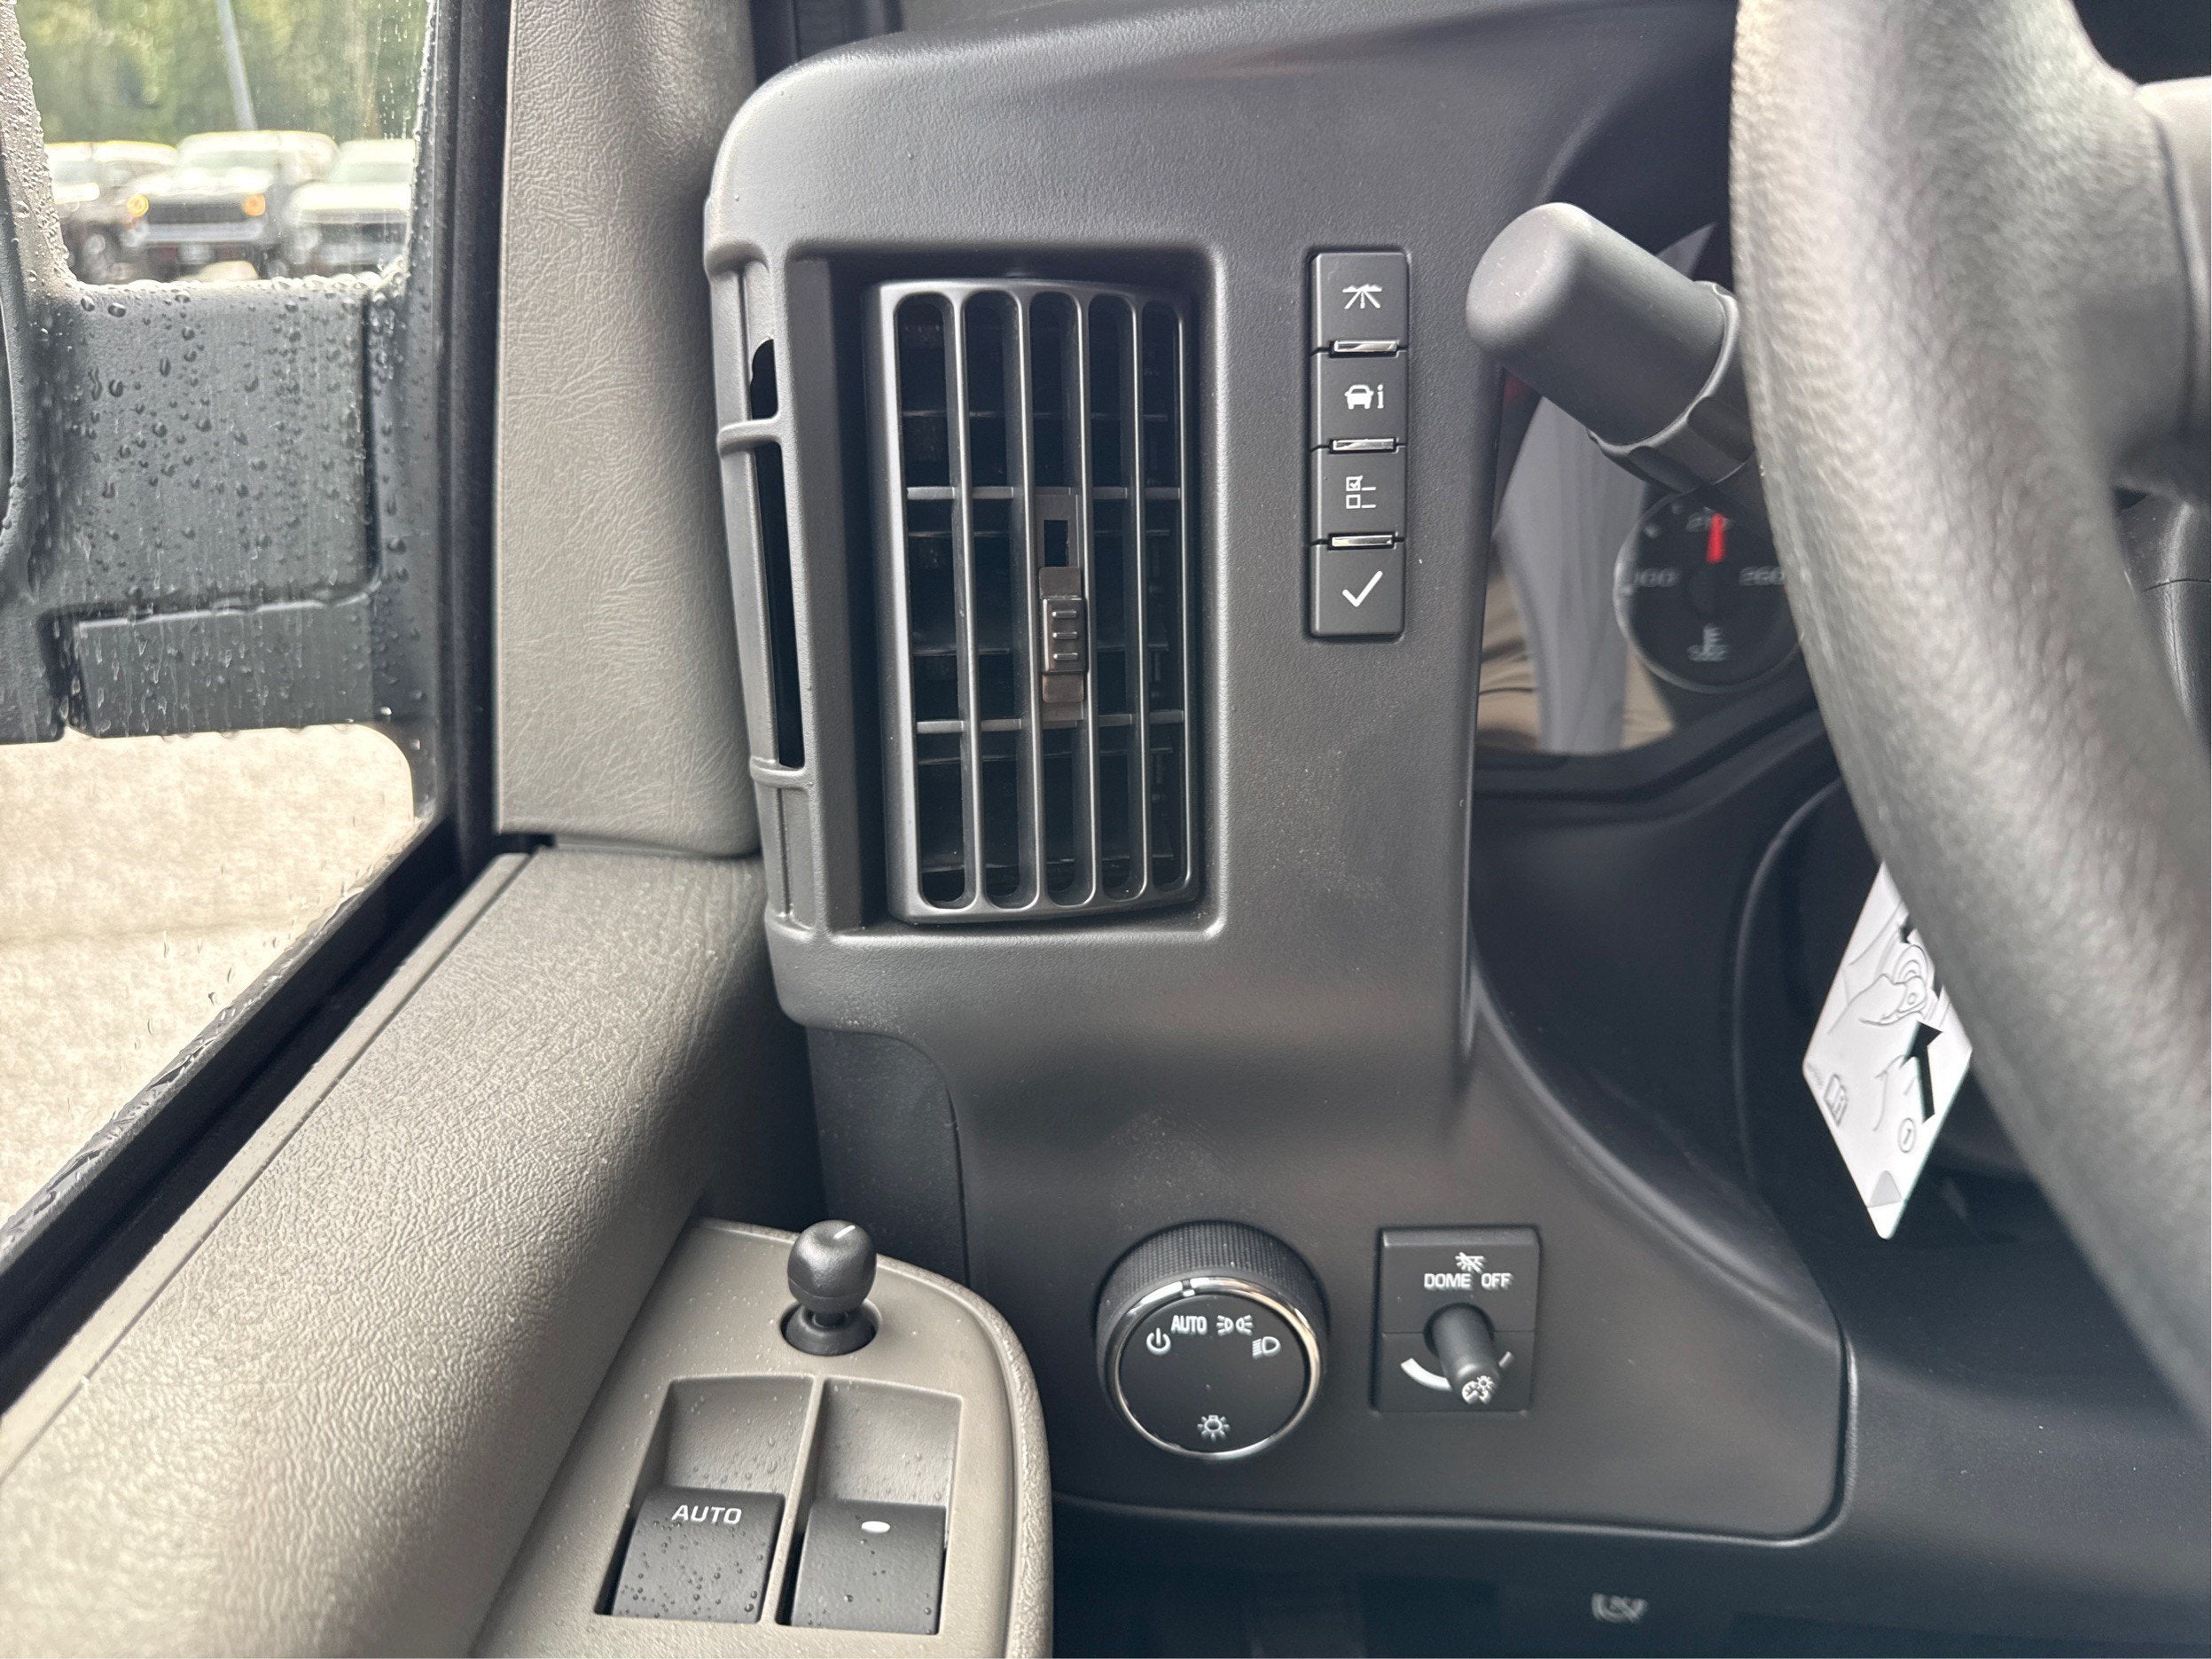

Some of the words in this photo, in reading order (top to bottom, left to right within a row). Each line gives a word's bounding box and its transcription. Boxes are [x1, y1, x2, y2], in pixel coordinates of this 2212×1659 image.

[1423, 1272, 1473, 1289] DOME
[1481, 1272, 1512, 1289] OFF
[1170, 1314, 1208, 1334] AUTO
[671, 1504, 742, 1524] AUTO
